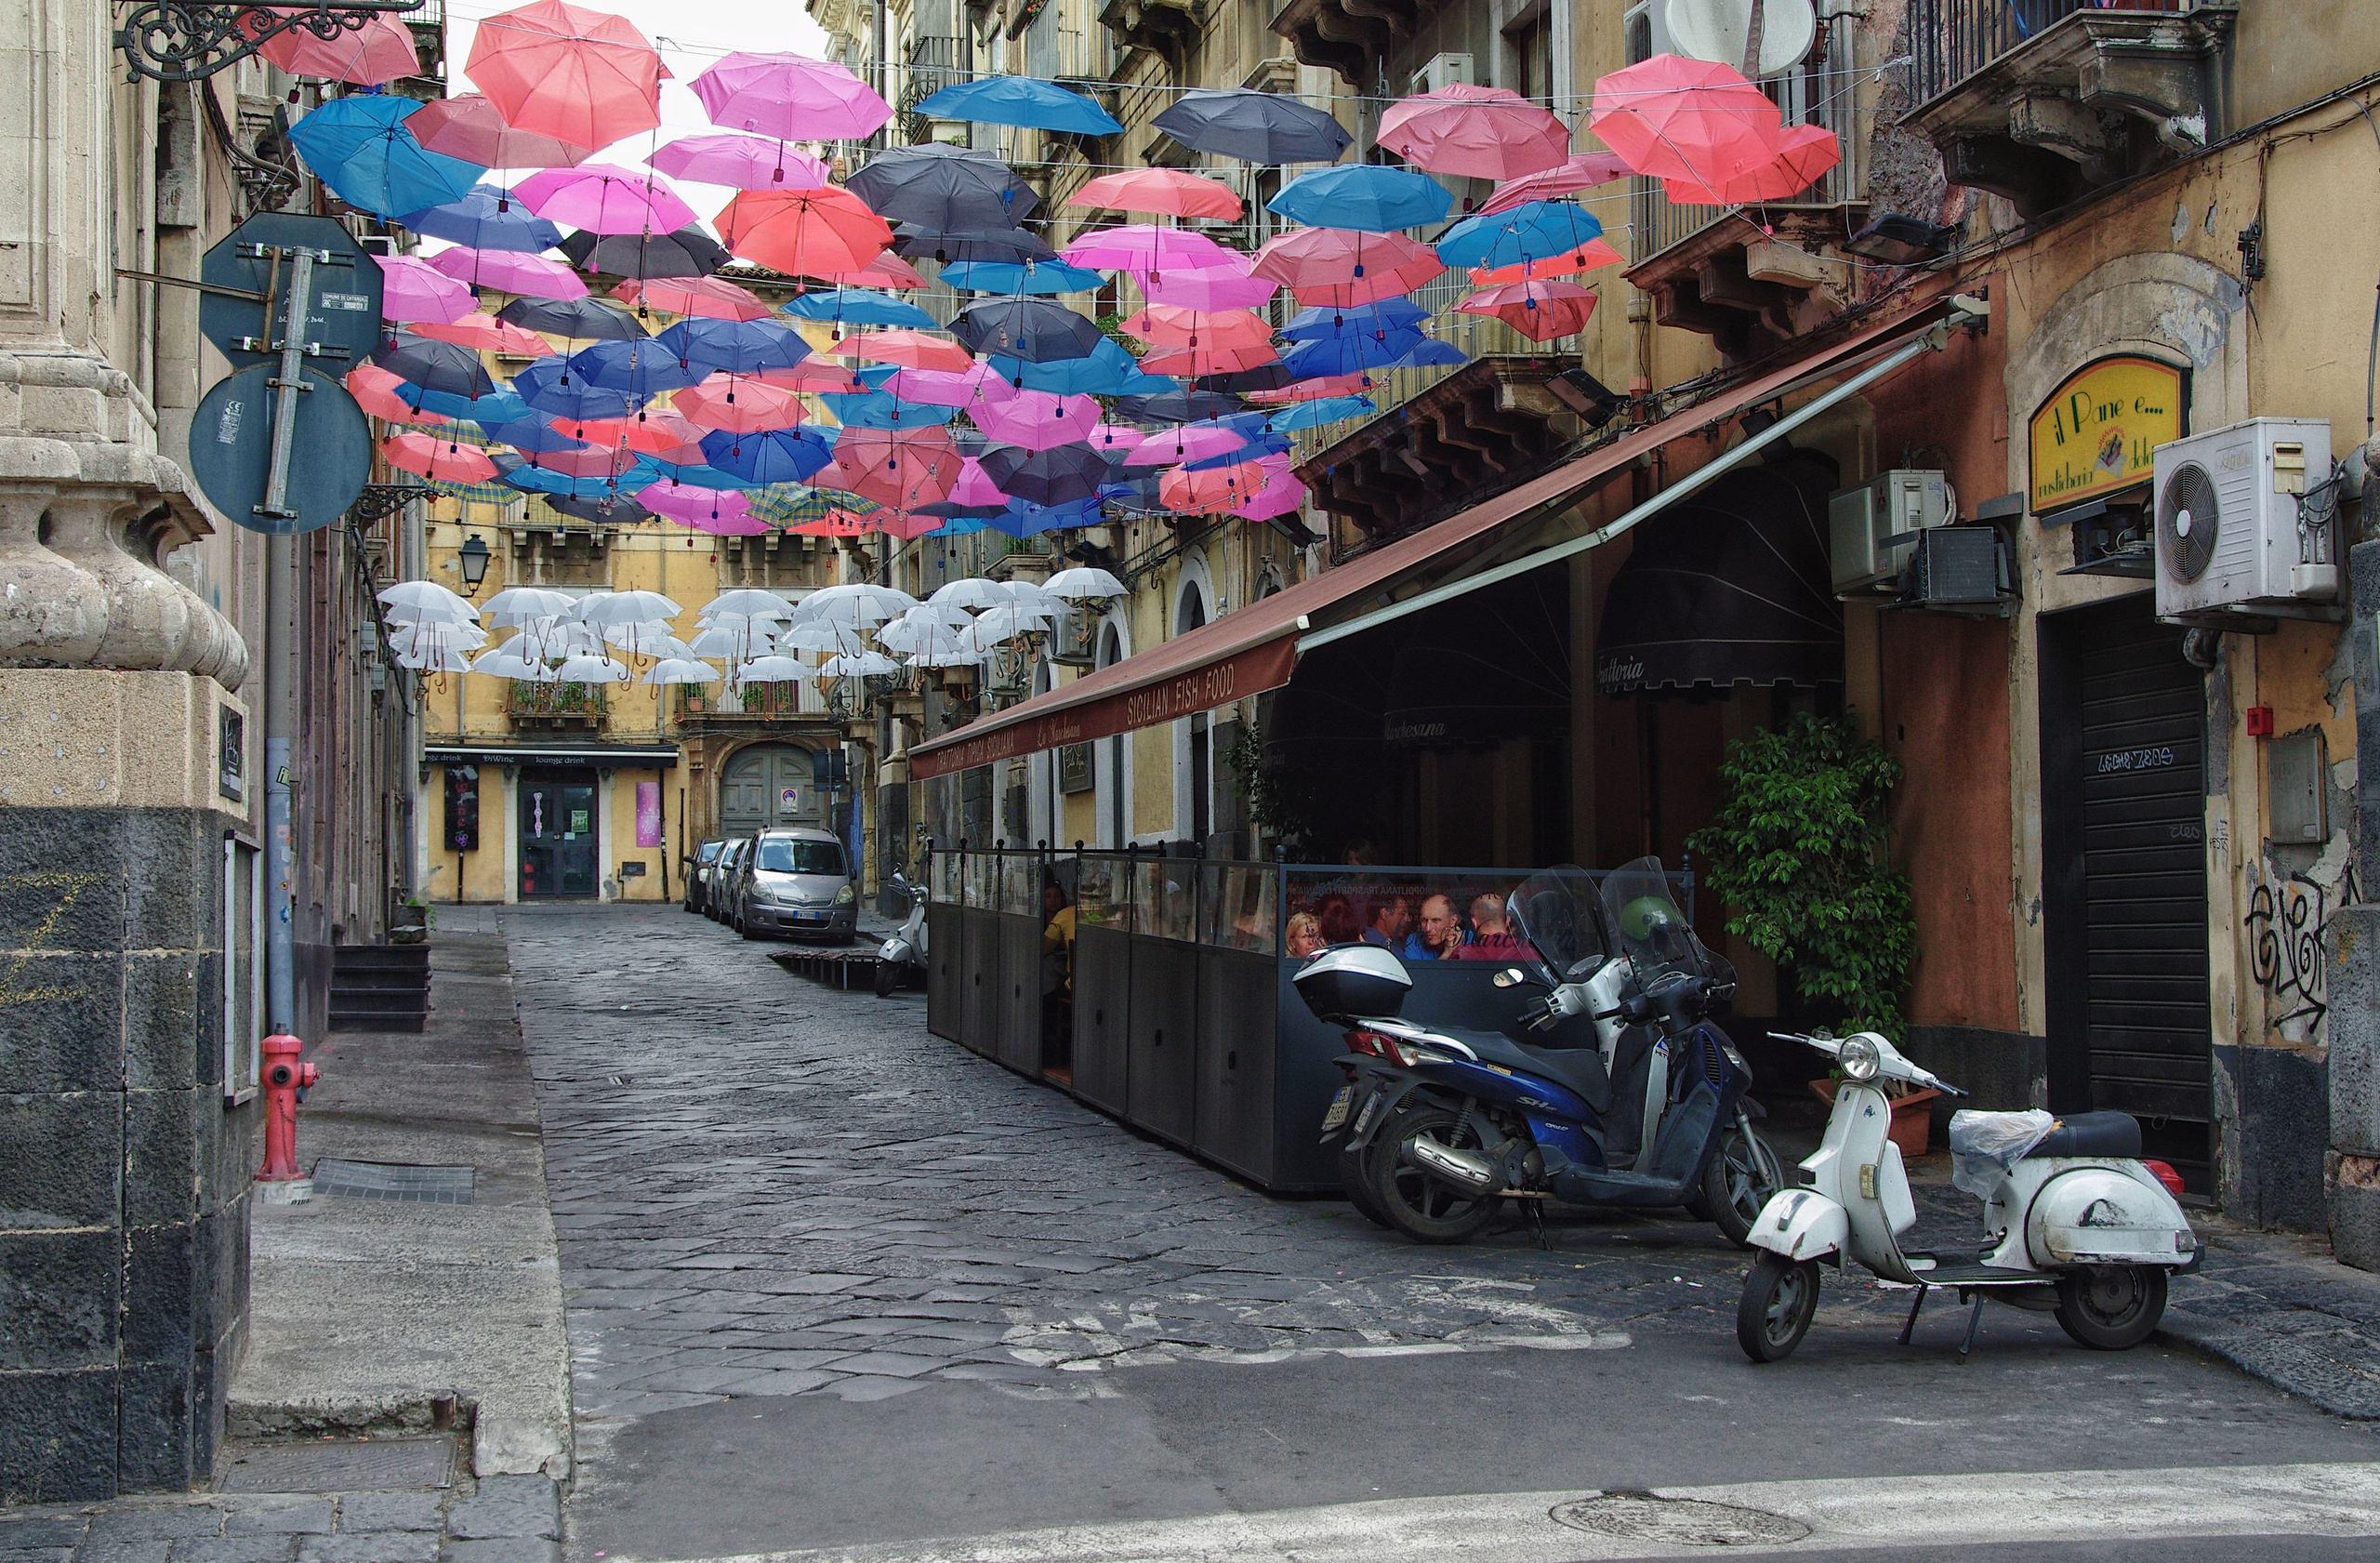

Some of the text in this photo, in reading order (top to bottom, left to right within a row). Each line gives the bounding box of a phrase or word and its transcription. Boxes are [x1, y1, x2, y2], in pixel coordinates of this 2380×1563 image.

[2054, 407, 2065, 446] il
[2070, 391, 2124, 434] Pane
[2038, 461, 2093, 497] rusticheria
[1127, 663, 1235, 726] SICILIAN FISH FOOD
[483, 754, 514, 763] DiWine
